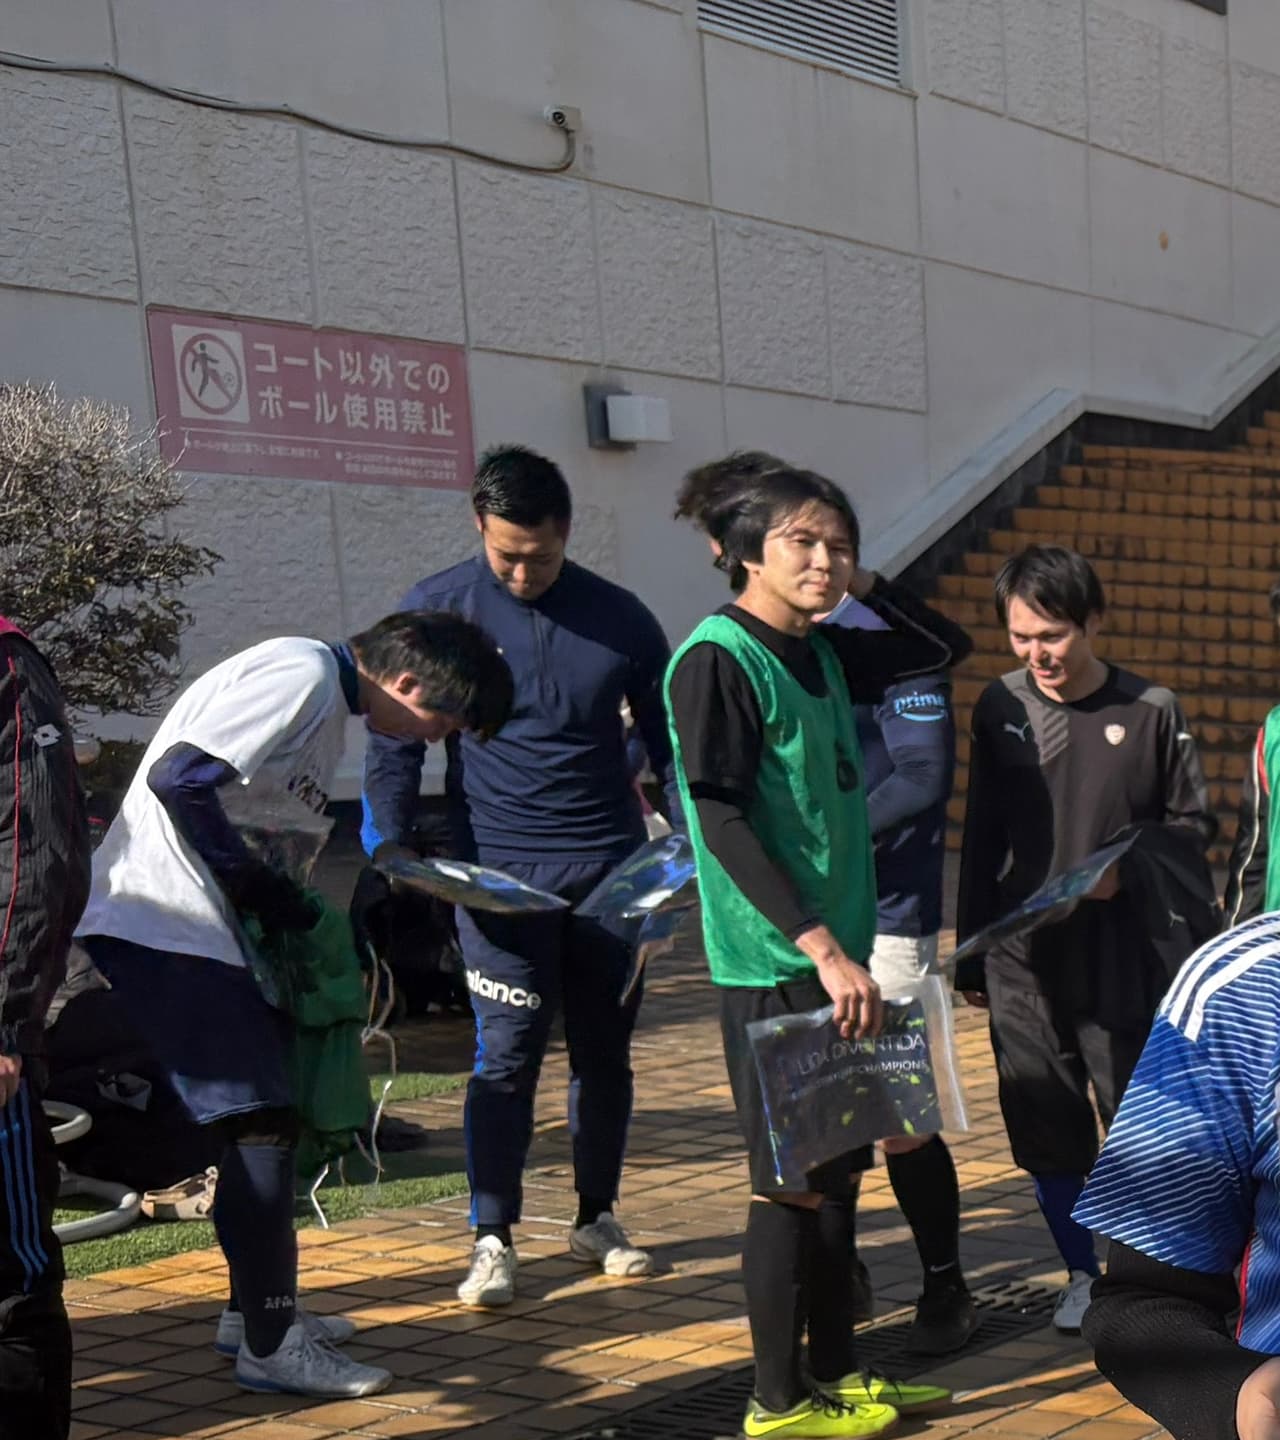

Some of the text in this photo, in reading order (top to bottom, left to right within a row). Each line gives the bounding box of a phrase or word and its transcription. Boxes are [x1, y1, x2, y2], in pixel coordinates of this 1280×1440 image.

[252, 342, 451, 394] コート以外での
[258, 385, 455, 437] ボール使用禁止
